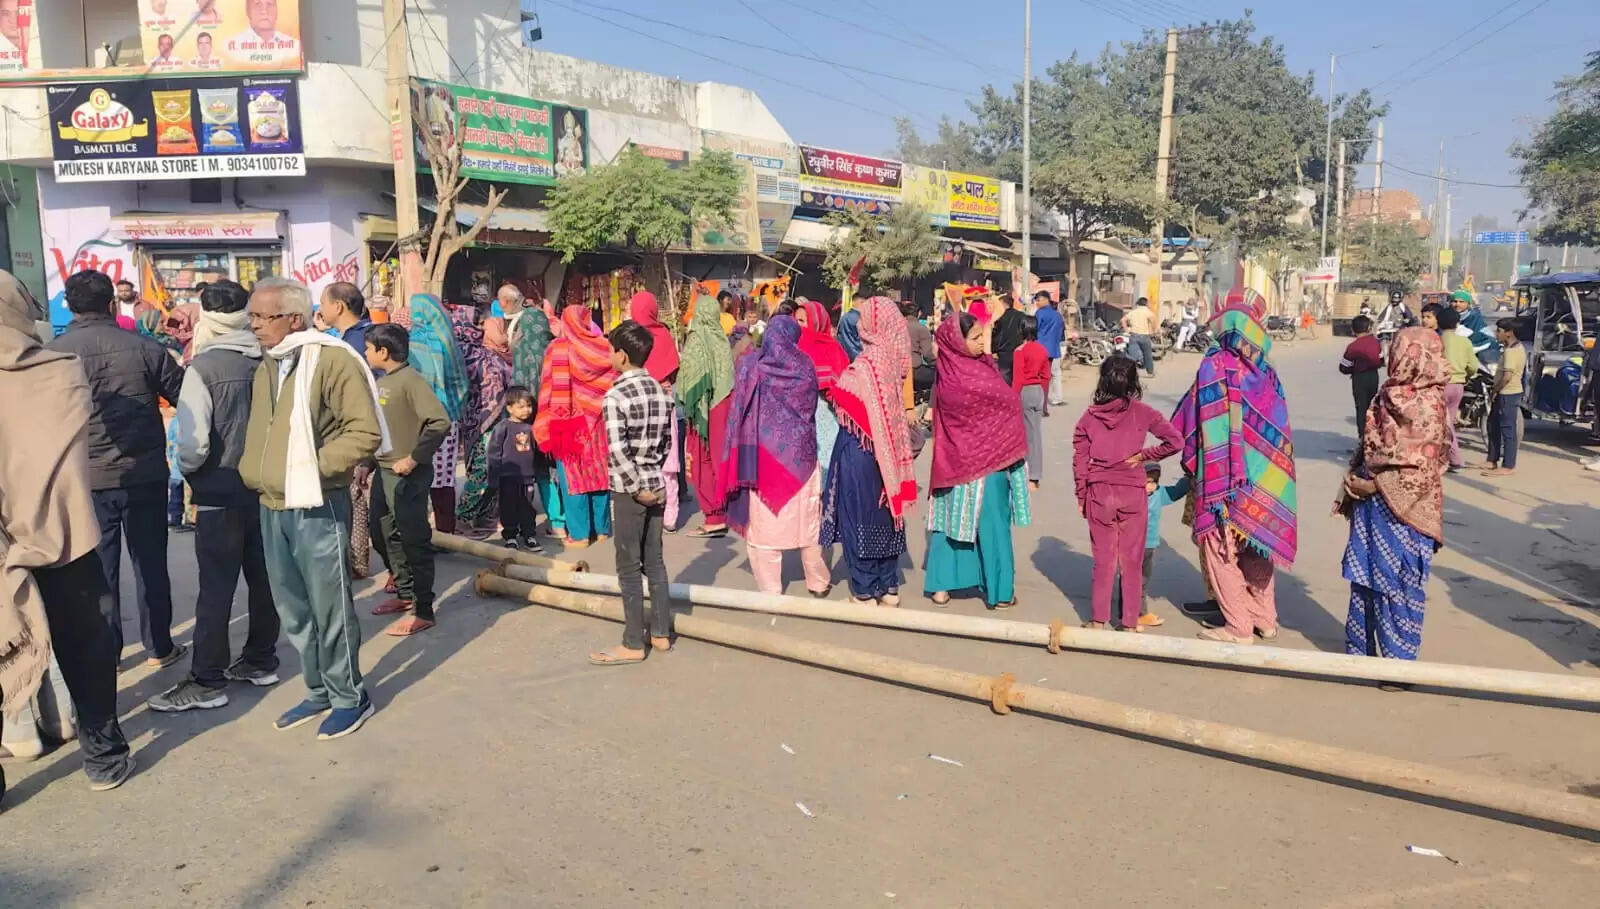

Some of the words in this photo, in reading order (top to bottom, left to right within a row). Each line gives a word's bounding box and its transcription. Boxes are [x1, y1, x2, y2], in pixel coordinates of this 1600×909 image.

[95, 95, 104, 105] G
[74, 111, 129, 129] Galaxy
[73, 144, 113, 154] BASMATI
[115, 143, 138, 153] RICE
[58, 161, 104, 177] MUKESH
[107, 160, 159, 175] KARYANA
[161, 159, 198, 173] STORE
[208, 158, 224, 172] M.
[227, 156, 298, 172] 9034100762
[875, 167, 897, 183] कुमार
[965, 181, 984, 198] पाल
[293, 257, 332, 287] Vita
